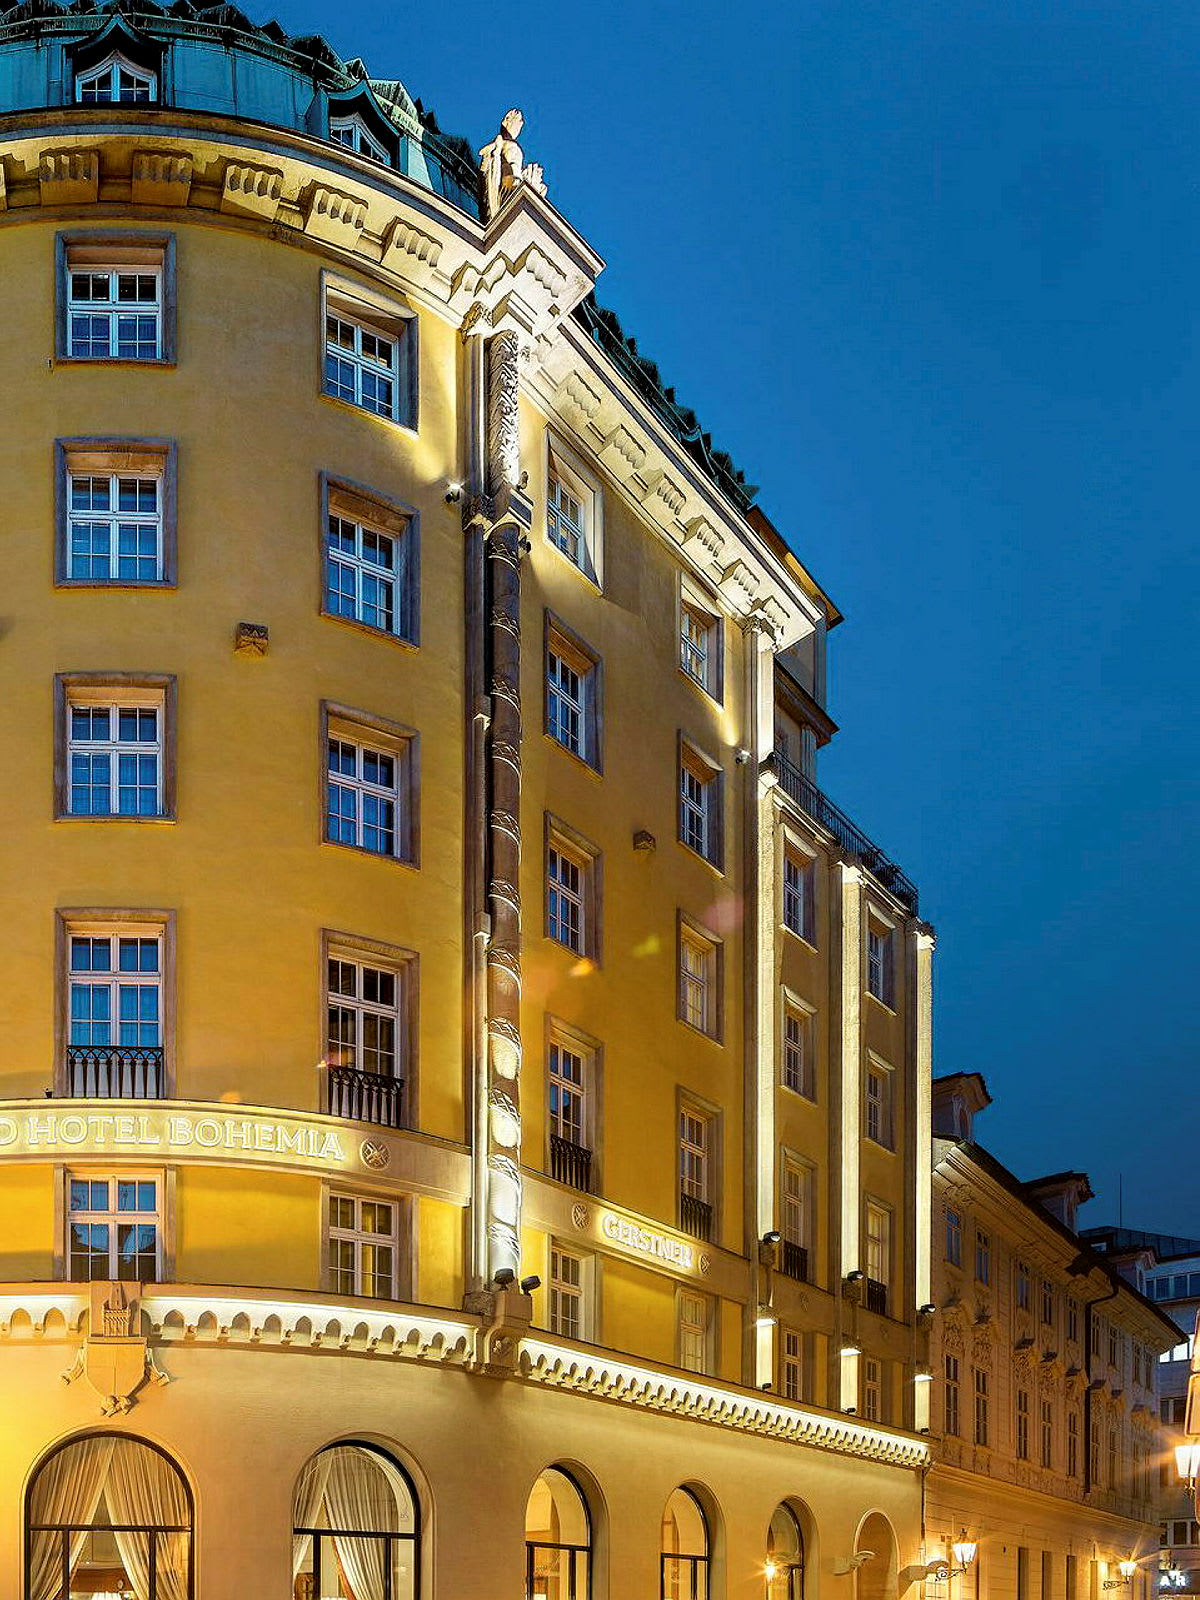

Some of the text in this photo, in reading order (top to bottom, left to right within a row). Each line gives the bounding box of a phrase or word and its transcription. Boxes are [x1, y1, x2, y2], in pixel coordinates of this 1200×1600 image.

[27, 1115, 160, 1145] HOTEL
[169, 1116, 346, 1161] BOHEMIA
[601, 1213, 692, 1268] GERSTNER
